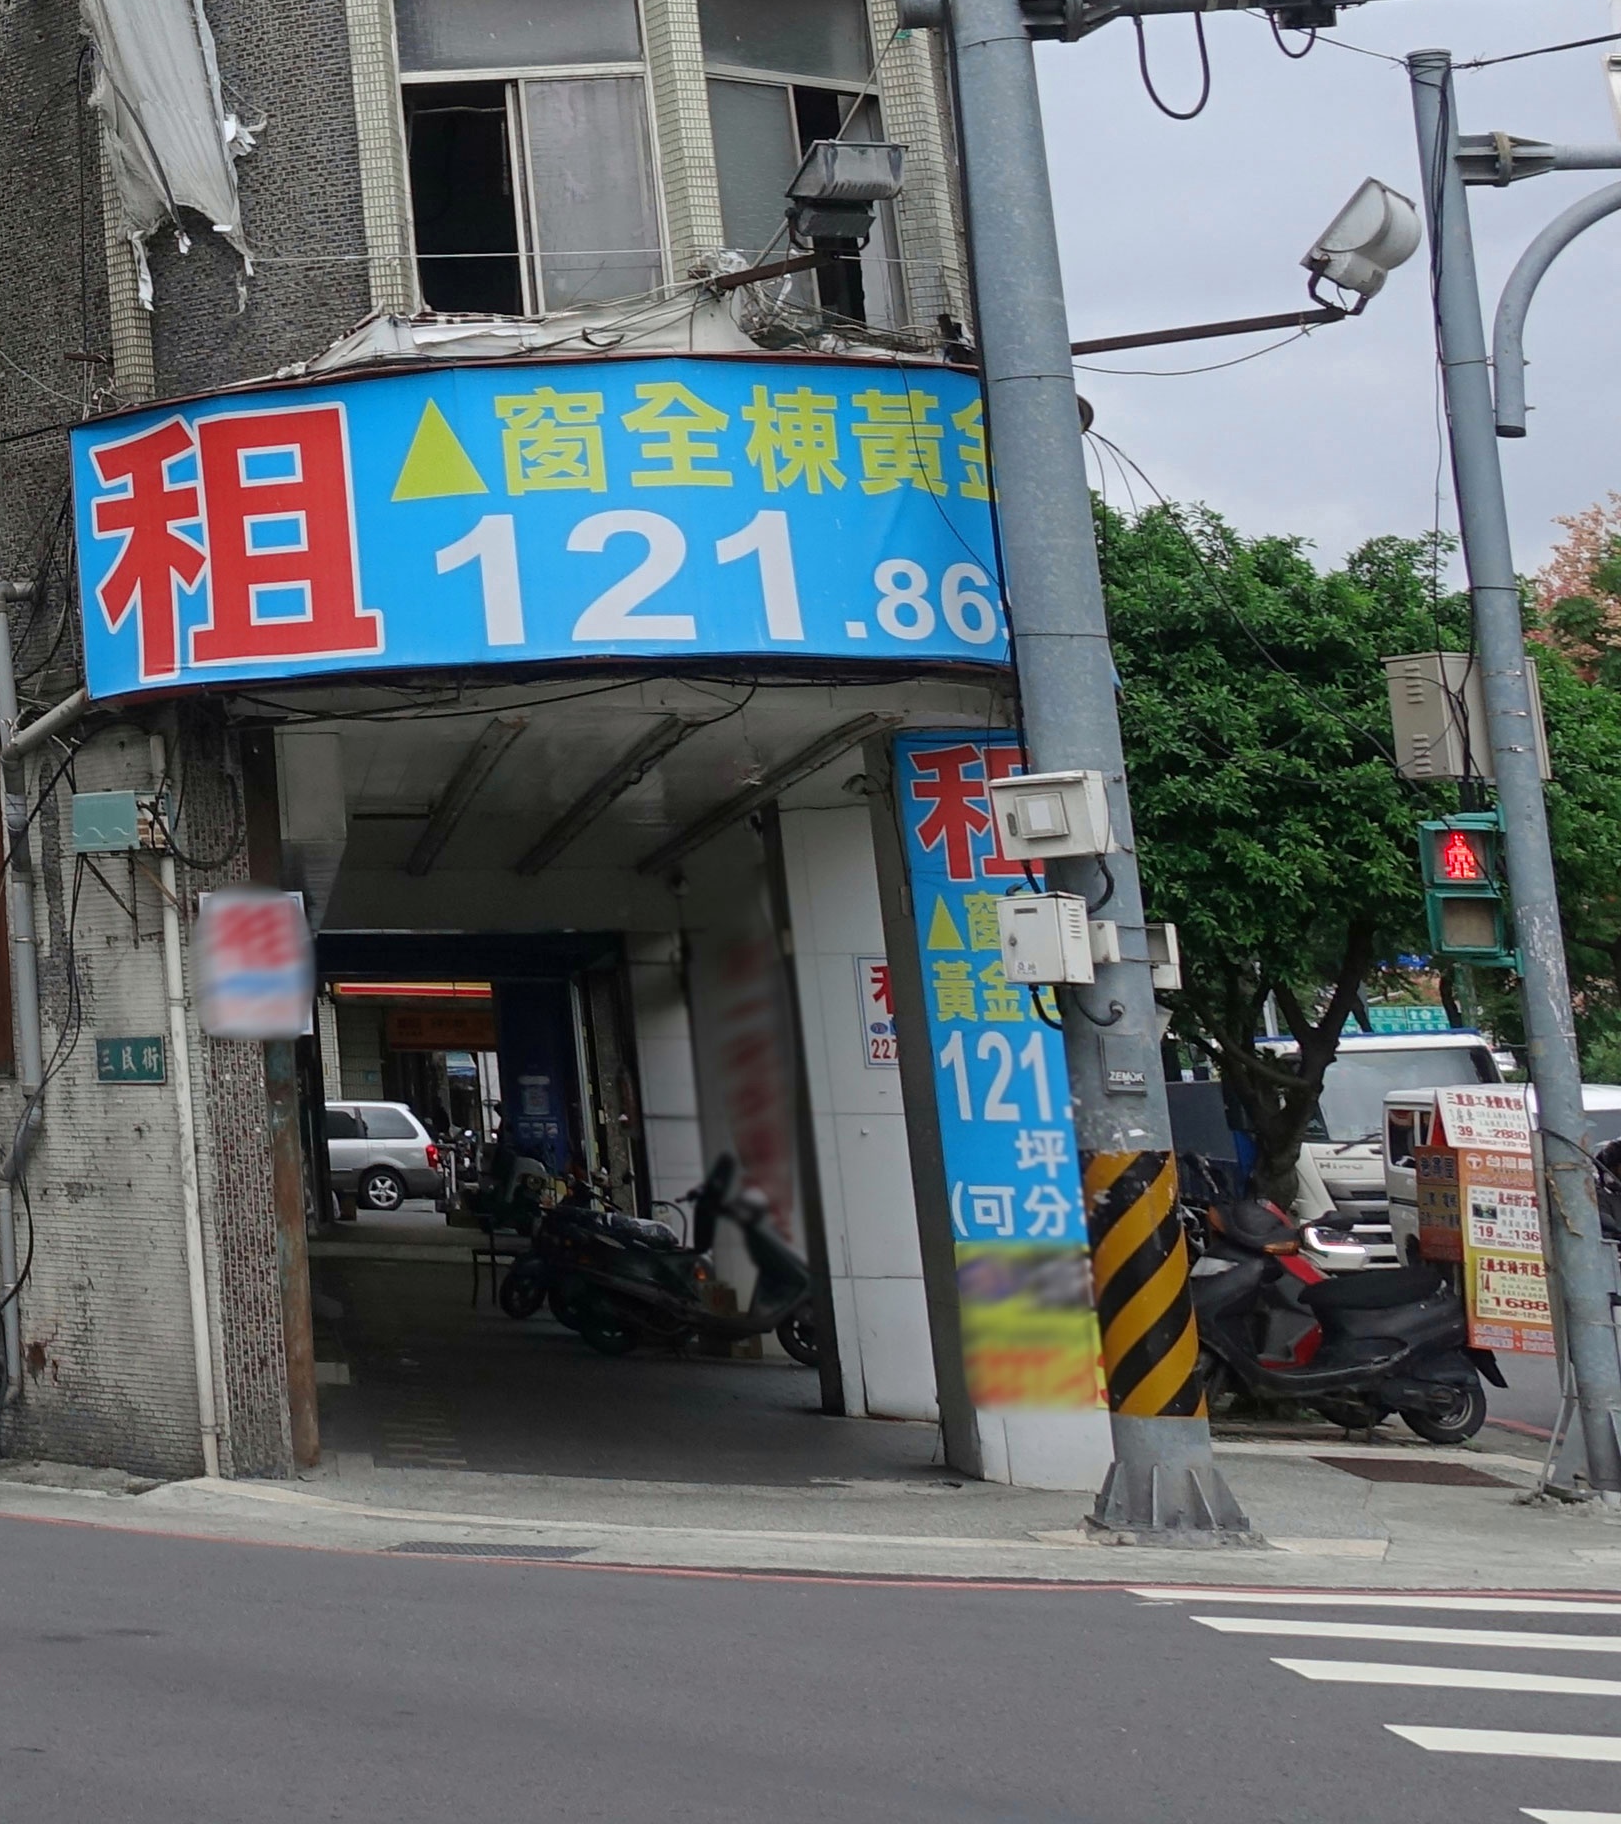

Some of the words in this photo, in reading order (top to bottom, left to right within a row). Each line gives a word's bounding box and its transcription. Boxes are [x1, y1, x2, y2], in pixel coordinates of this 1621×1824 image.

[93, 401, 384, 684] 租
[435, 509, 1011, 647] 121.86
[100, 1045, 160, 1073] 三民街
[1015, 1129, 1069, 1179] 坪
[1457, 1125, 1474, 1137] 39
[952, 1181, 1086, 1238] (可分
[1478, 1224, 1495, 1238] 19
